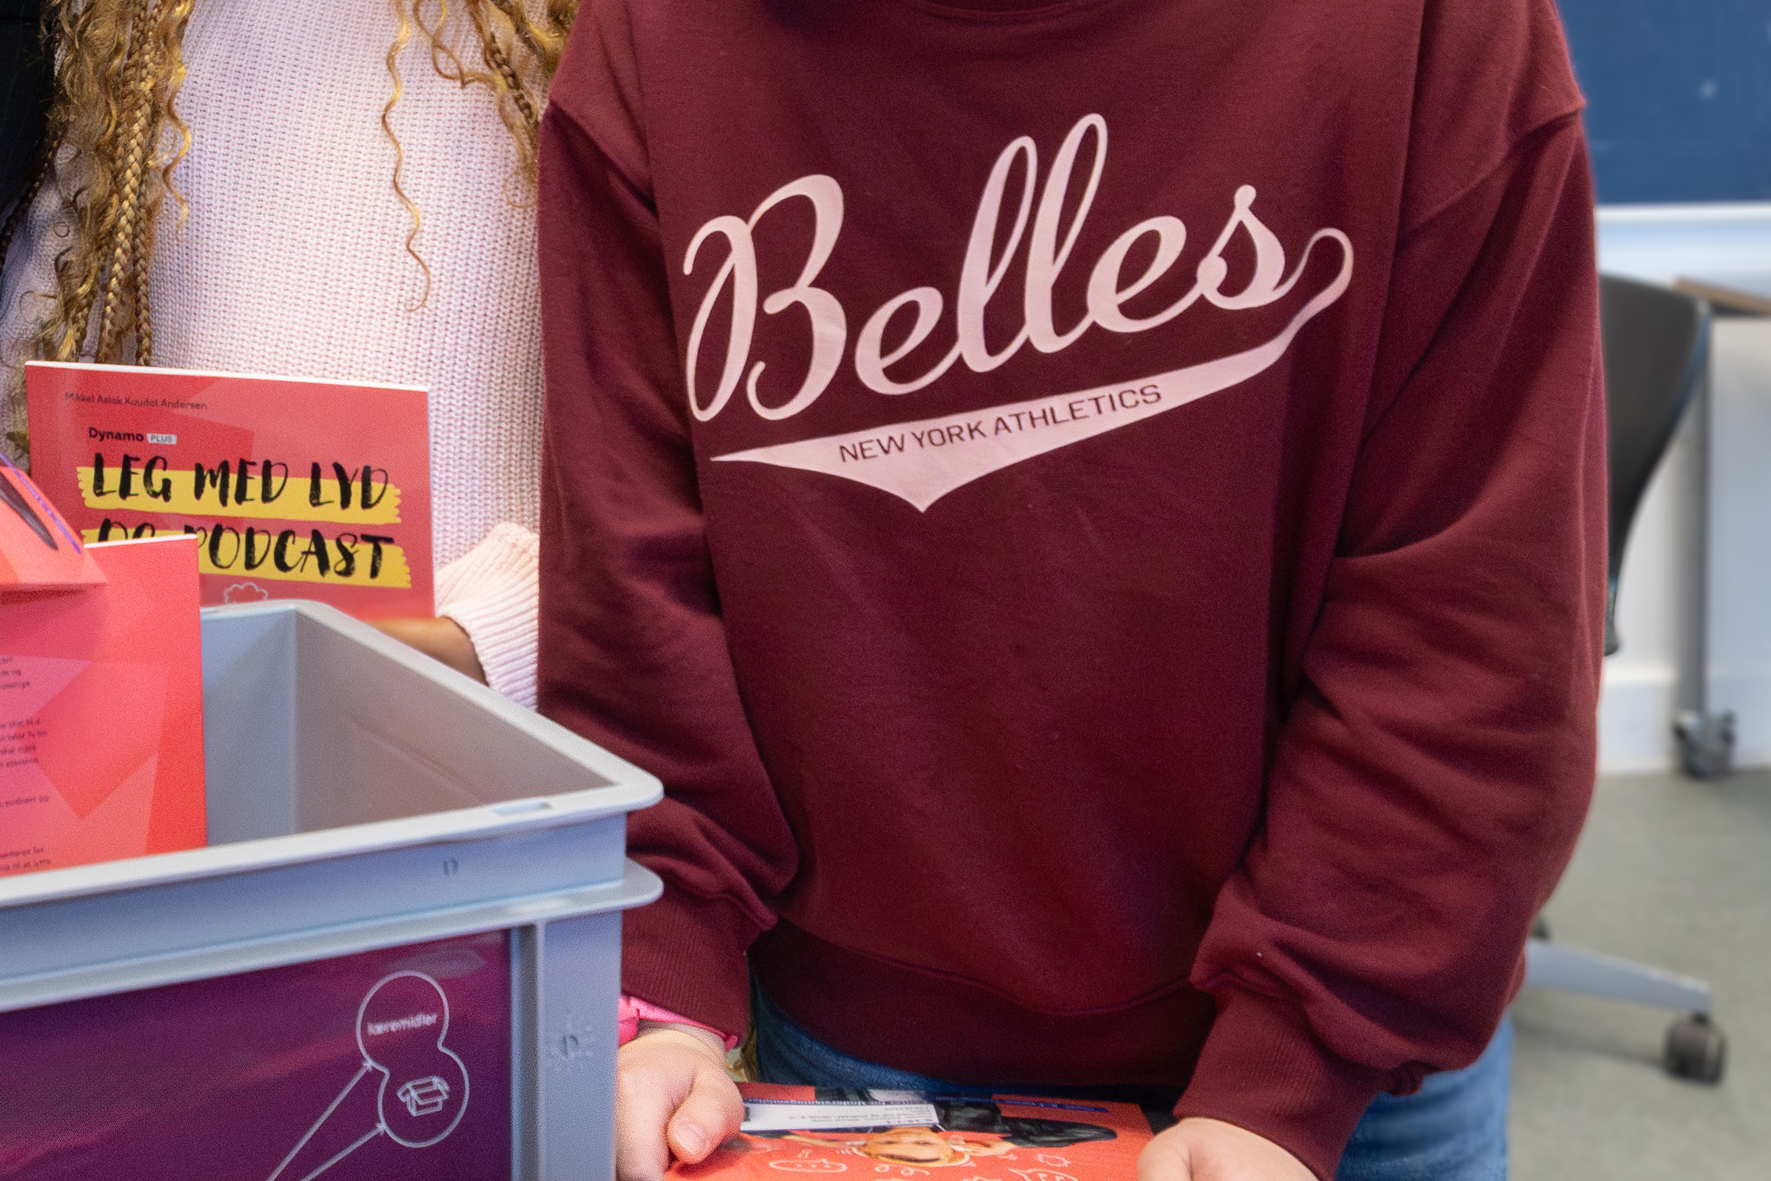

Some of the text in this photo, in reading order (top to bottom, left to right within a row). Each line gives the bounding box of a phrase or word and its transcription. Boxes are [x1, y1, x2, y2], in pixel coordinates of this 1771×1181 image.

[684, 113, 1288, 421] Belles
[161, 399, 207, 410] Andersen
[839, 384, 1163, 463] NEW YORK ATHLETICS
[88, 427, 173, 443] Dynamo PLUS
[93, 452, 389, 510] LEG MED LYD
